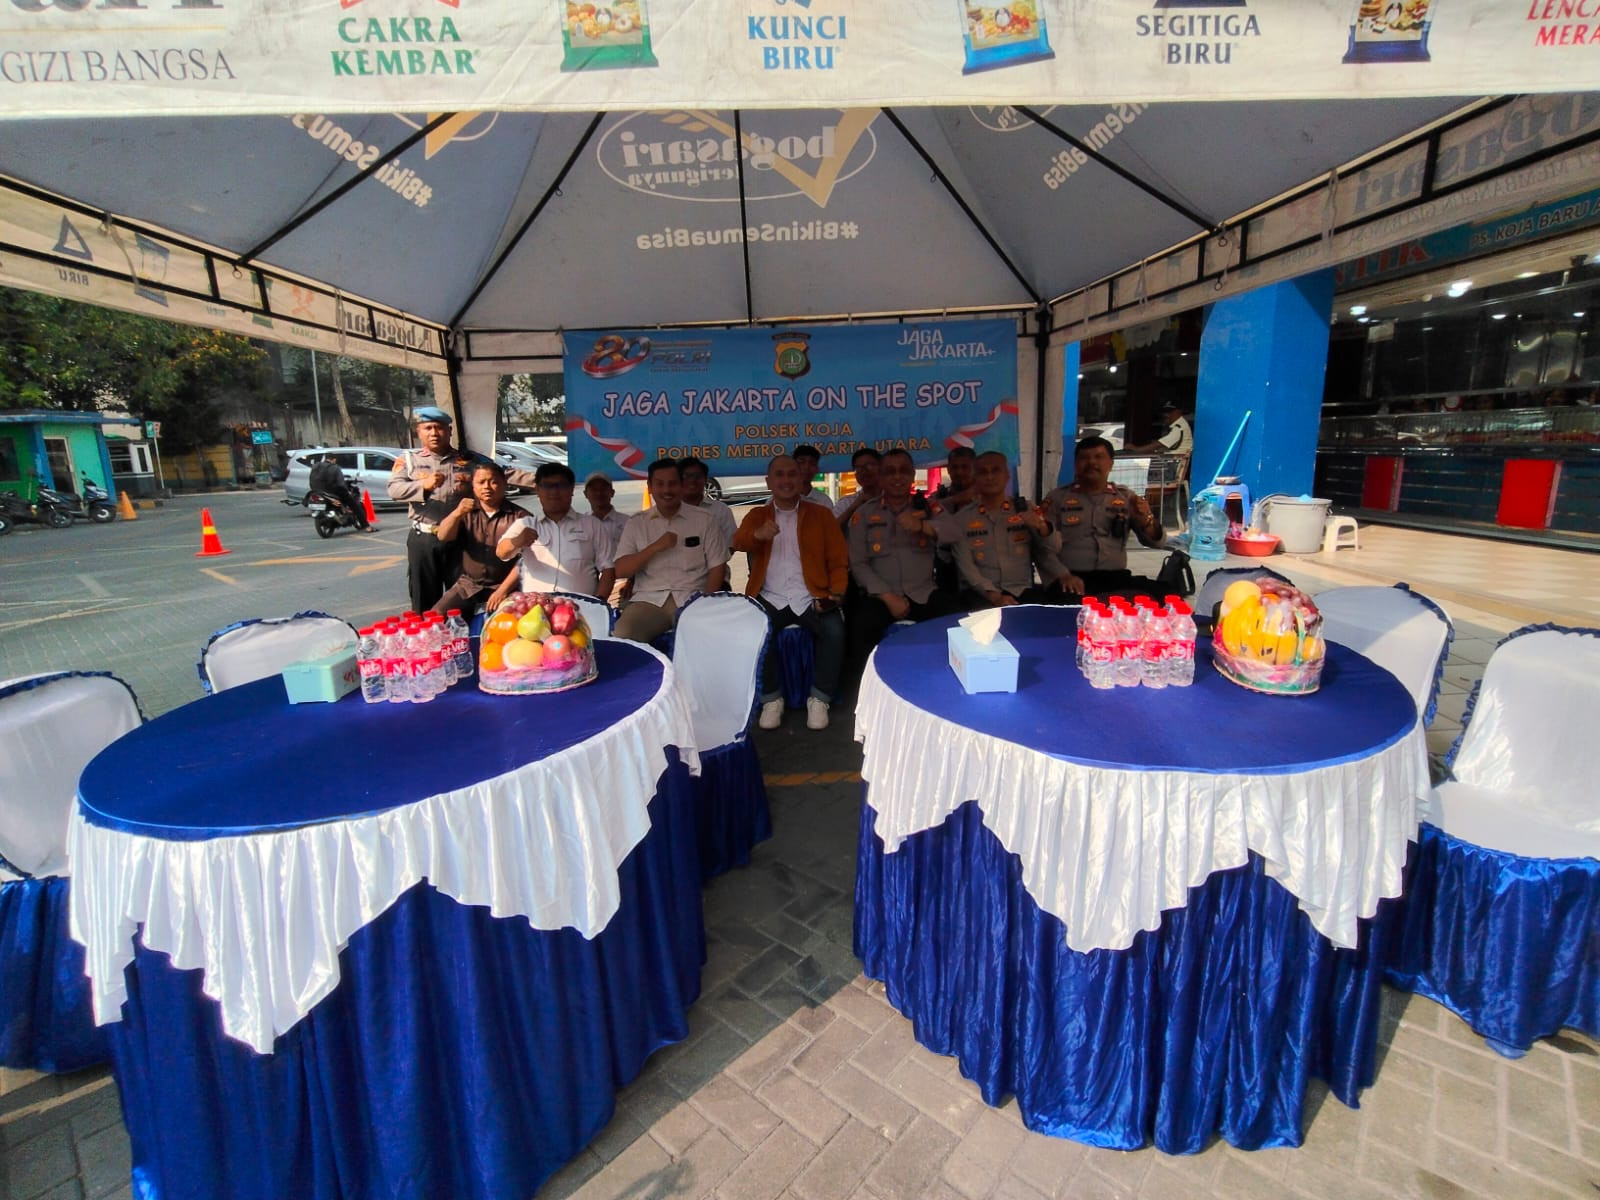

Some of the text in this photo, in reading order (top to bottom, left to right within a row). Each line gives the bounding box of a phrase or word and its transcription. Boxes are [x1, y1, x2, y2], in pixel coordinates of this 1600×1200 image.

[338, 16, 462, 44] CAKRA
[747, 15, 847, 40] KUNCI
[1136, 14, 1261, 38] SEGITIGA
[0, 48, 237, 83] GIZI BANGSA
[331, 49, 477, 76] KEMBAR
[763, 46, 834, 70] BIRU
[1166, 42, 1232, 65] BIRU
[1494, 216, 1535, 241] KOJA
[1537, 202, 1588, 231] BARU
[897, 329, 944, 346] JAGA
[602, 379, 983, 419] JAGA JAKARTA ON THE SPOT
[735, 422, 853, 440] POLSEK KOJA
[657, 445, 722, 460] POLRES
[727, 443, 786, 459] METRO
[795, 440, 867, 456] KARTA
